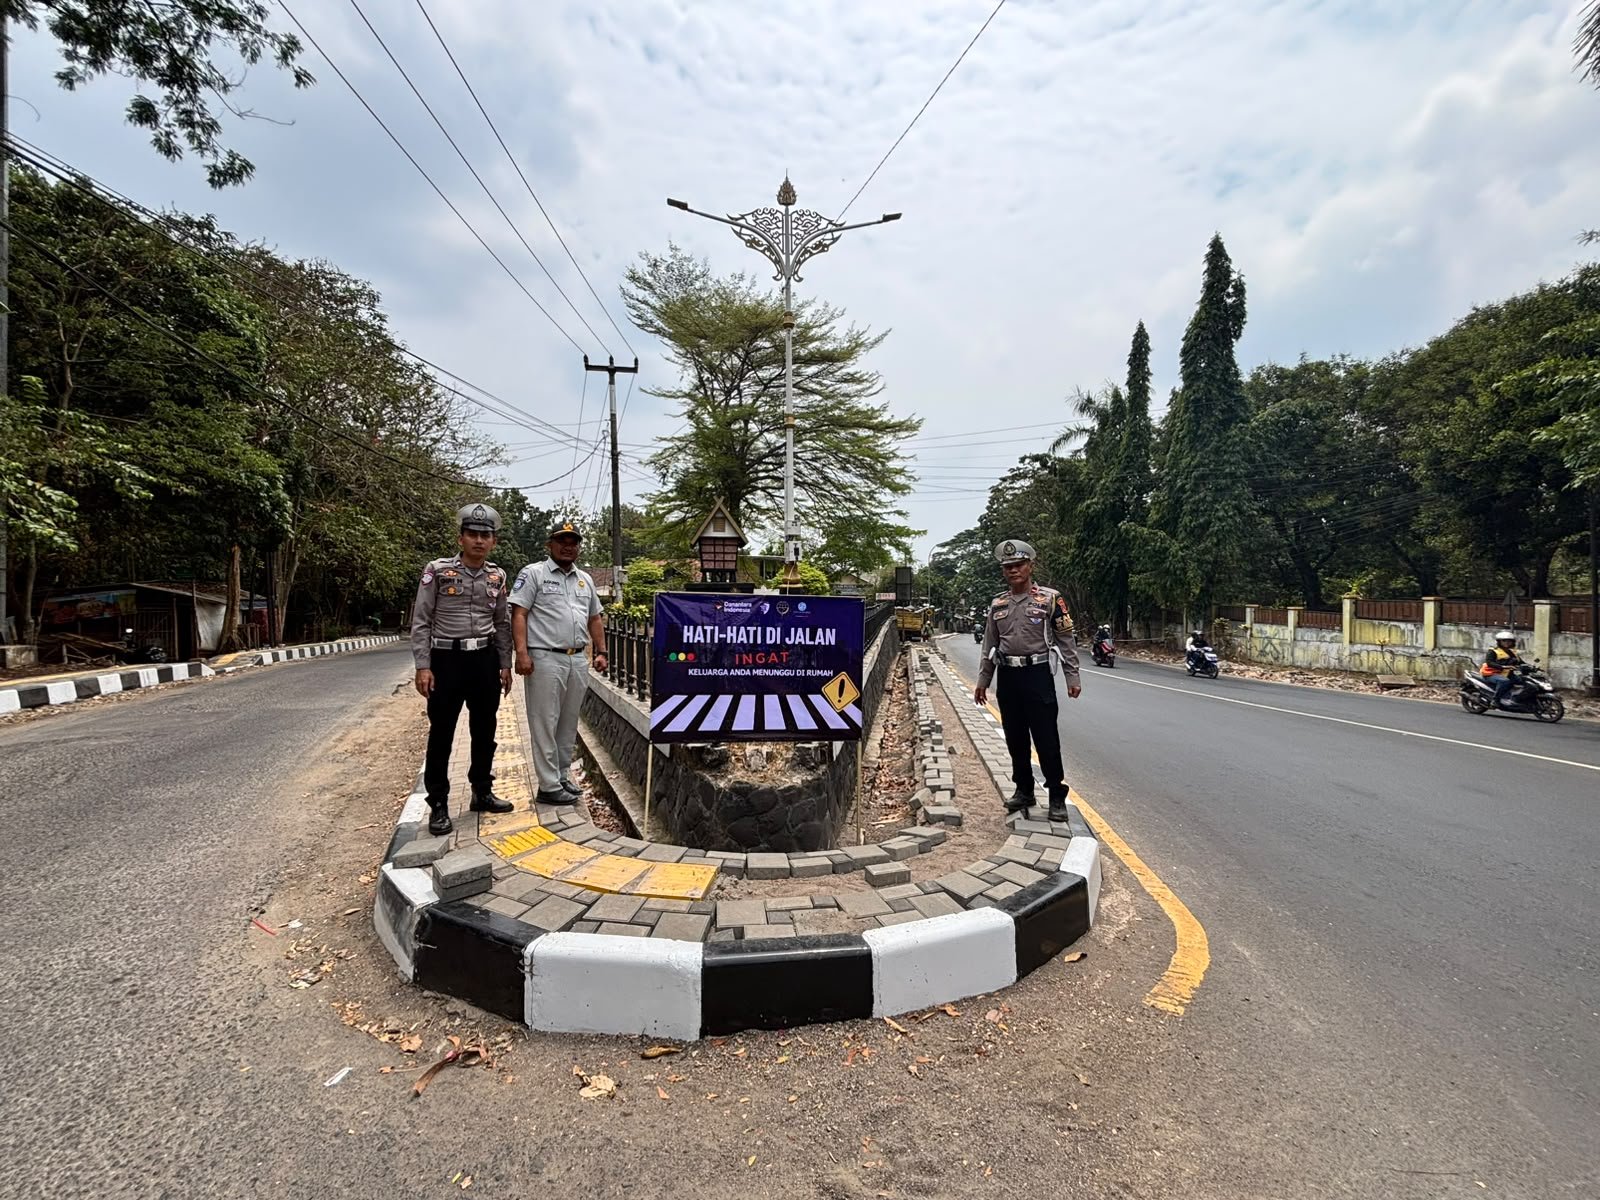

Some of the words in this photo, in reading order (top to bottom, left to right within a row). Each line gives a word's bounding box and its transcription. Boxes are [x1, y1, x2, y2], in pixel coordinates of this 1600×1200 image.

[682, 625, 762, 645] HATI-HATI
[766, 626, 781, 645] DI
[785, 627, 836, 646] JALAN
[735, 651, 790, 665] INGAT
[688, 668, 728, 676] KELUARGA
[730, 668, 751, 676] ANDA
[752, 668, 795, 677] MENUNGGU
[796, 669, 805, 677] DI
[807, 669, 834, 677] RUMAH
